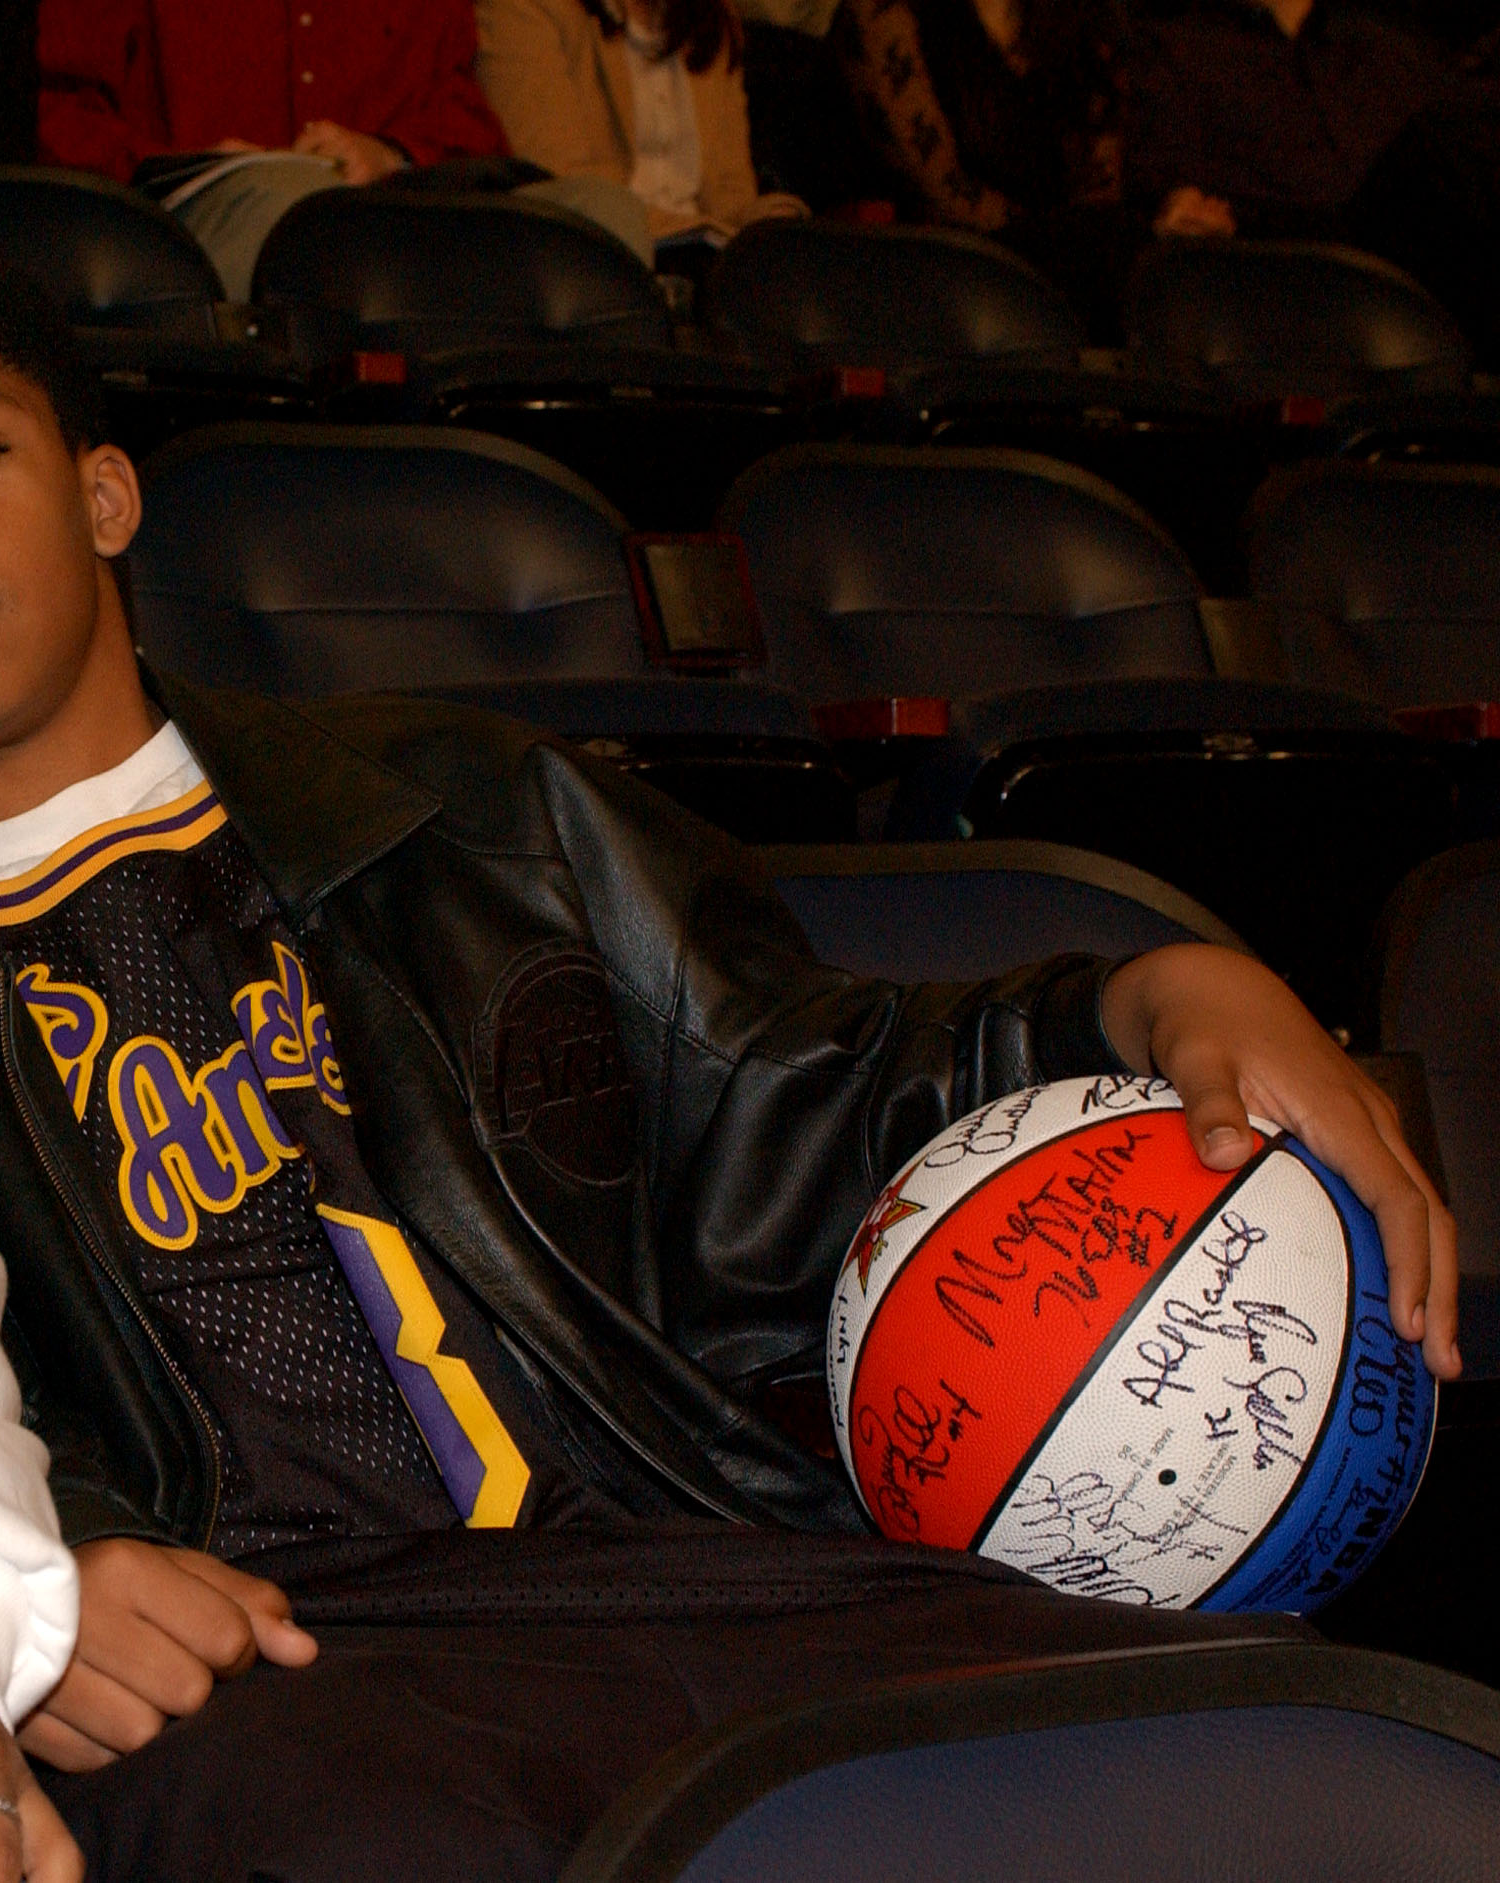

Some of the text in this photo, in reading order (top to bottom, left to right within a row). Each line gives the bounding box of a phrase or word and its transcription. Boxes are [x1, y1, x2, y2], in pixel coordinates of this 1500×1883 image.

[1148, 1425, 1174, 1457] MADE
[1196, 1440, 1229, 1485] INFLATE
[1303, 1506, 1391, 1592] NBA
